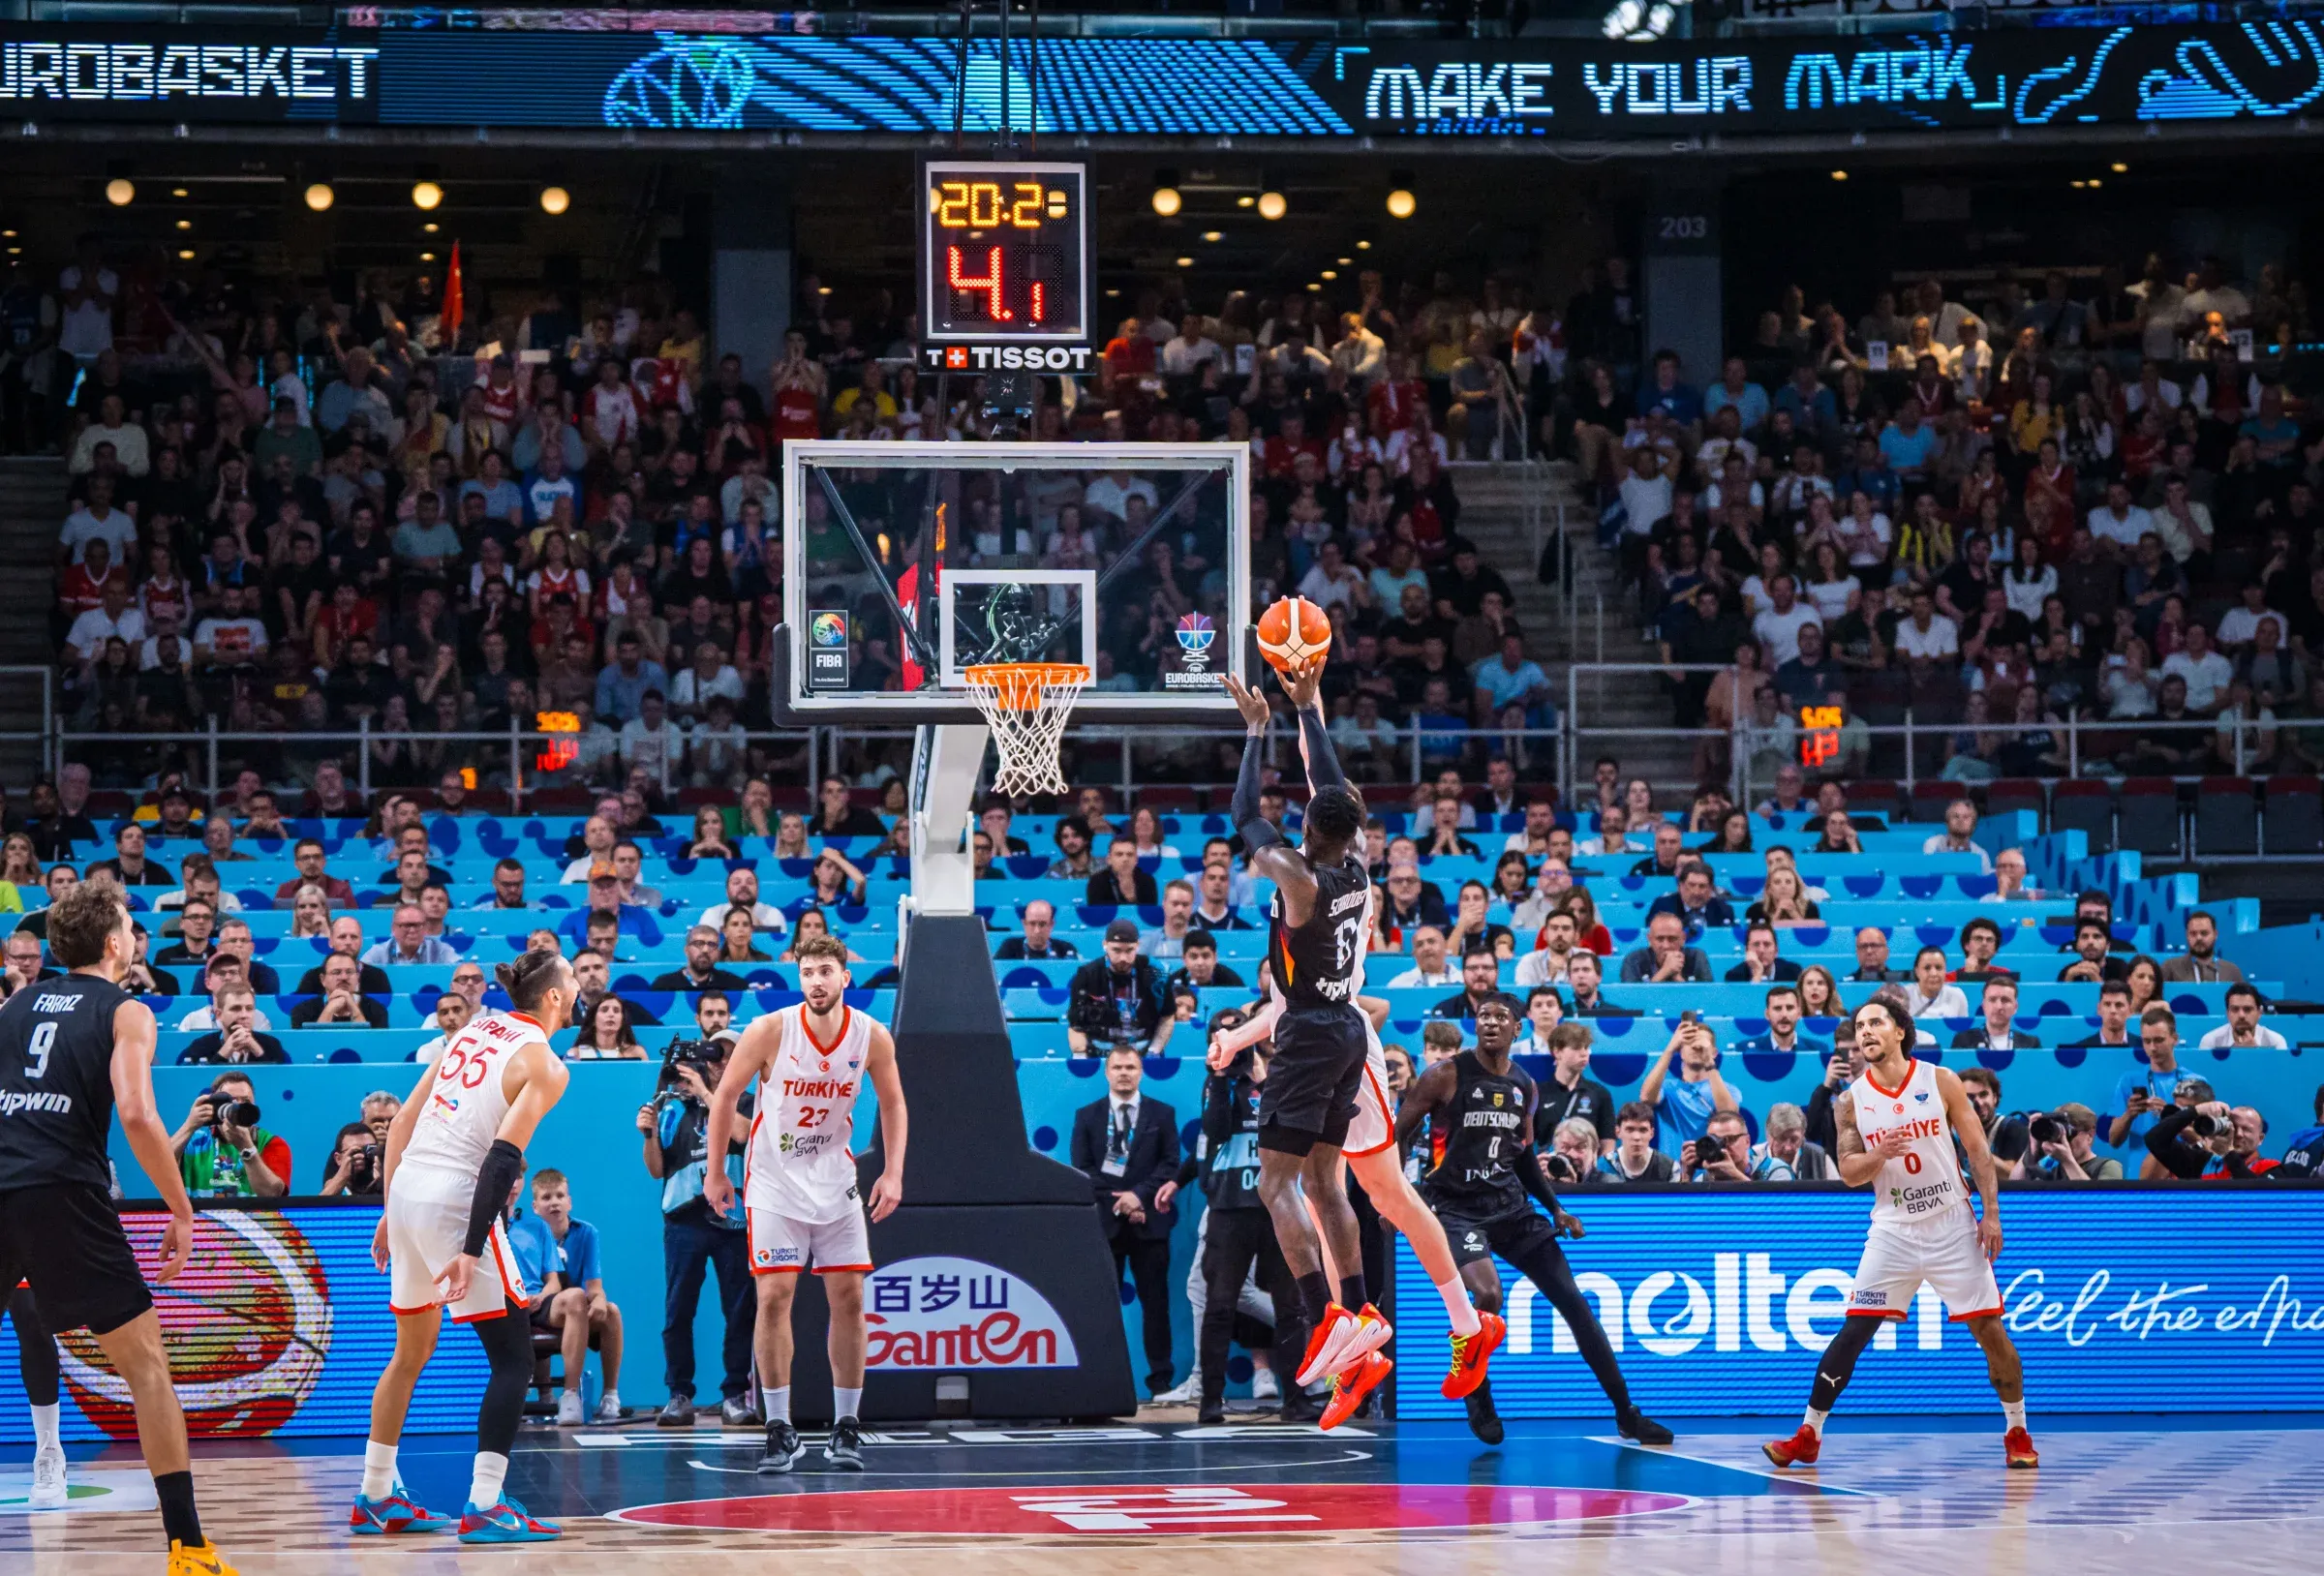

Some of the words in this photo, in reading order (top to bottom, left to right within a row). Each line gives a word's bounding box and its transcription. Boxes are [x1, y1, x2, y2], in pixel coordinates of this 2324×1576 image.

[1365, 63, 1553, 118] MAKE
[1583, 56, 1753, 113] YOUR
[1784, 44, 1975, 108] MARK
[1658, 217, 1708, 238] 203
[971, 347, 1091, 370] TISSOT
[816, 654, 842, 668] FIBA
[24, 1021, 58, 1078] 9
[440, 1036, 499, 1089] 55
[782, 1077, 854, 1099] TÜRKİYE
[797, 1106, 830, 1129] 23
[1488, 1136, 1501, 1159] 0
[1904, 1152, 1922, 1175] 0
[1903, 1179, 1952, 1201] Garanti
[1908, 1197, 1944, 1214] BBVA
[872, 1274, 1008, 1314] 百岁山
[1508, 1253, 1942, 1355] molten
[2106, 1281, 2209, 1341] the
